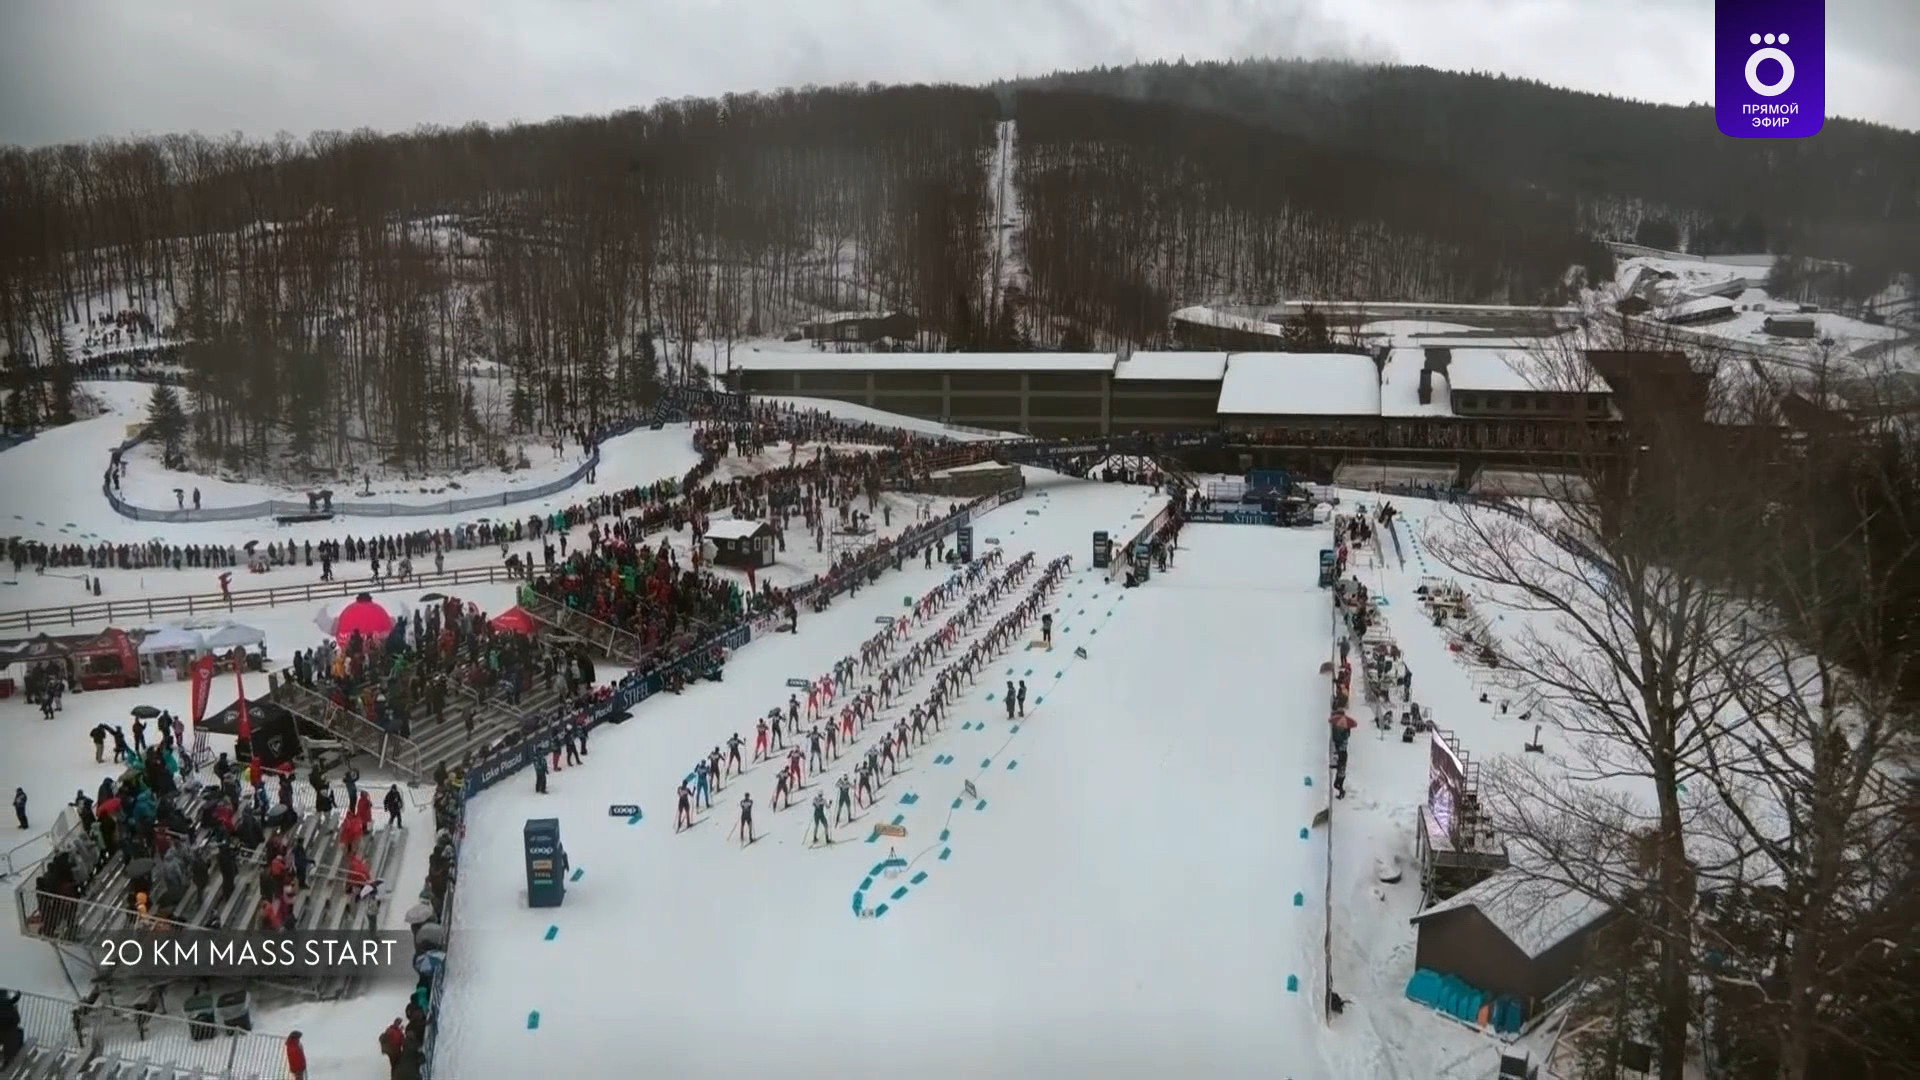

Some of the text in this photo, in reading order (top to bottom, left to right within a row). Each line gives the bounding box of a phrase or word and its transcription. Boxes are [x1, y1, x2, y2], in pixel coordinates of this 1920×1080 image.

[622, 682, 650, 710] STIFEL
[481, 753, 523, 783] Lake Placid
[613, 806, 637, 815] coop
[529, 847, 554, 855] coop
